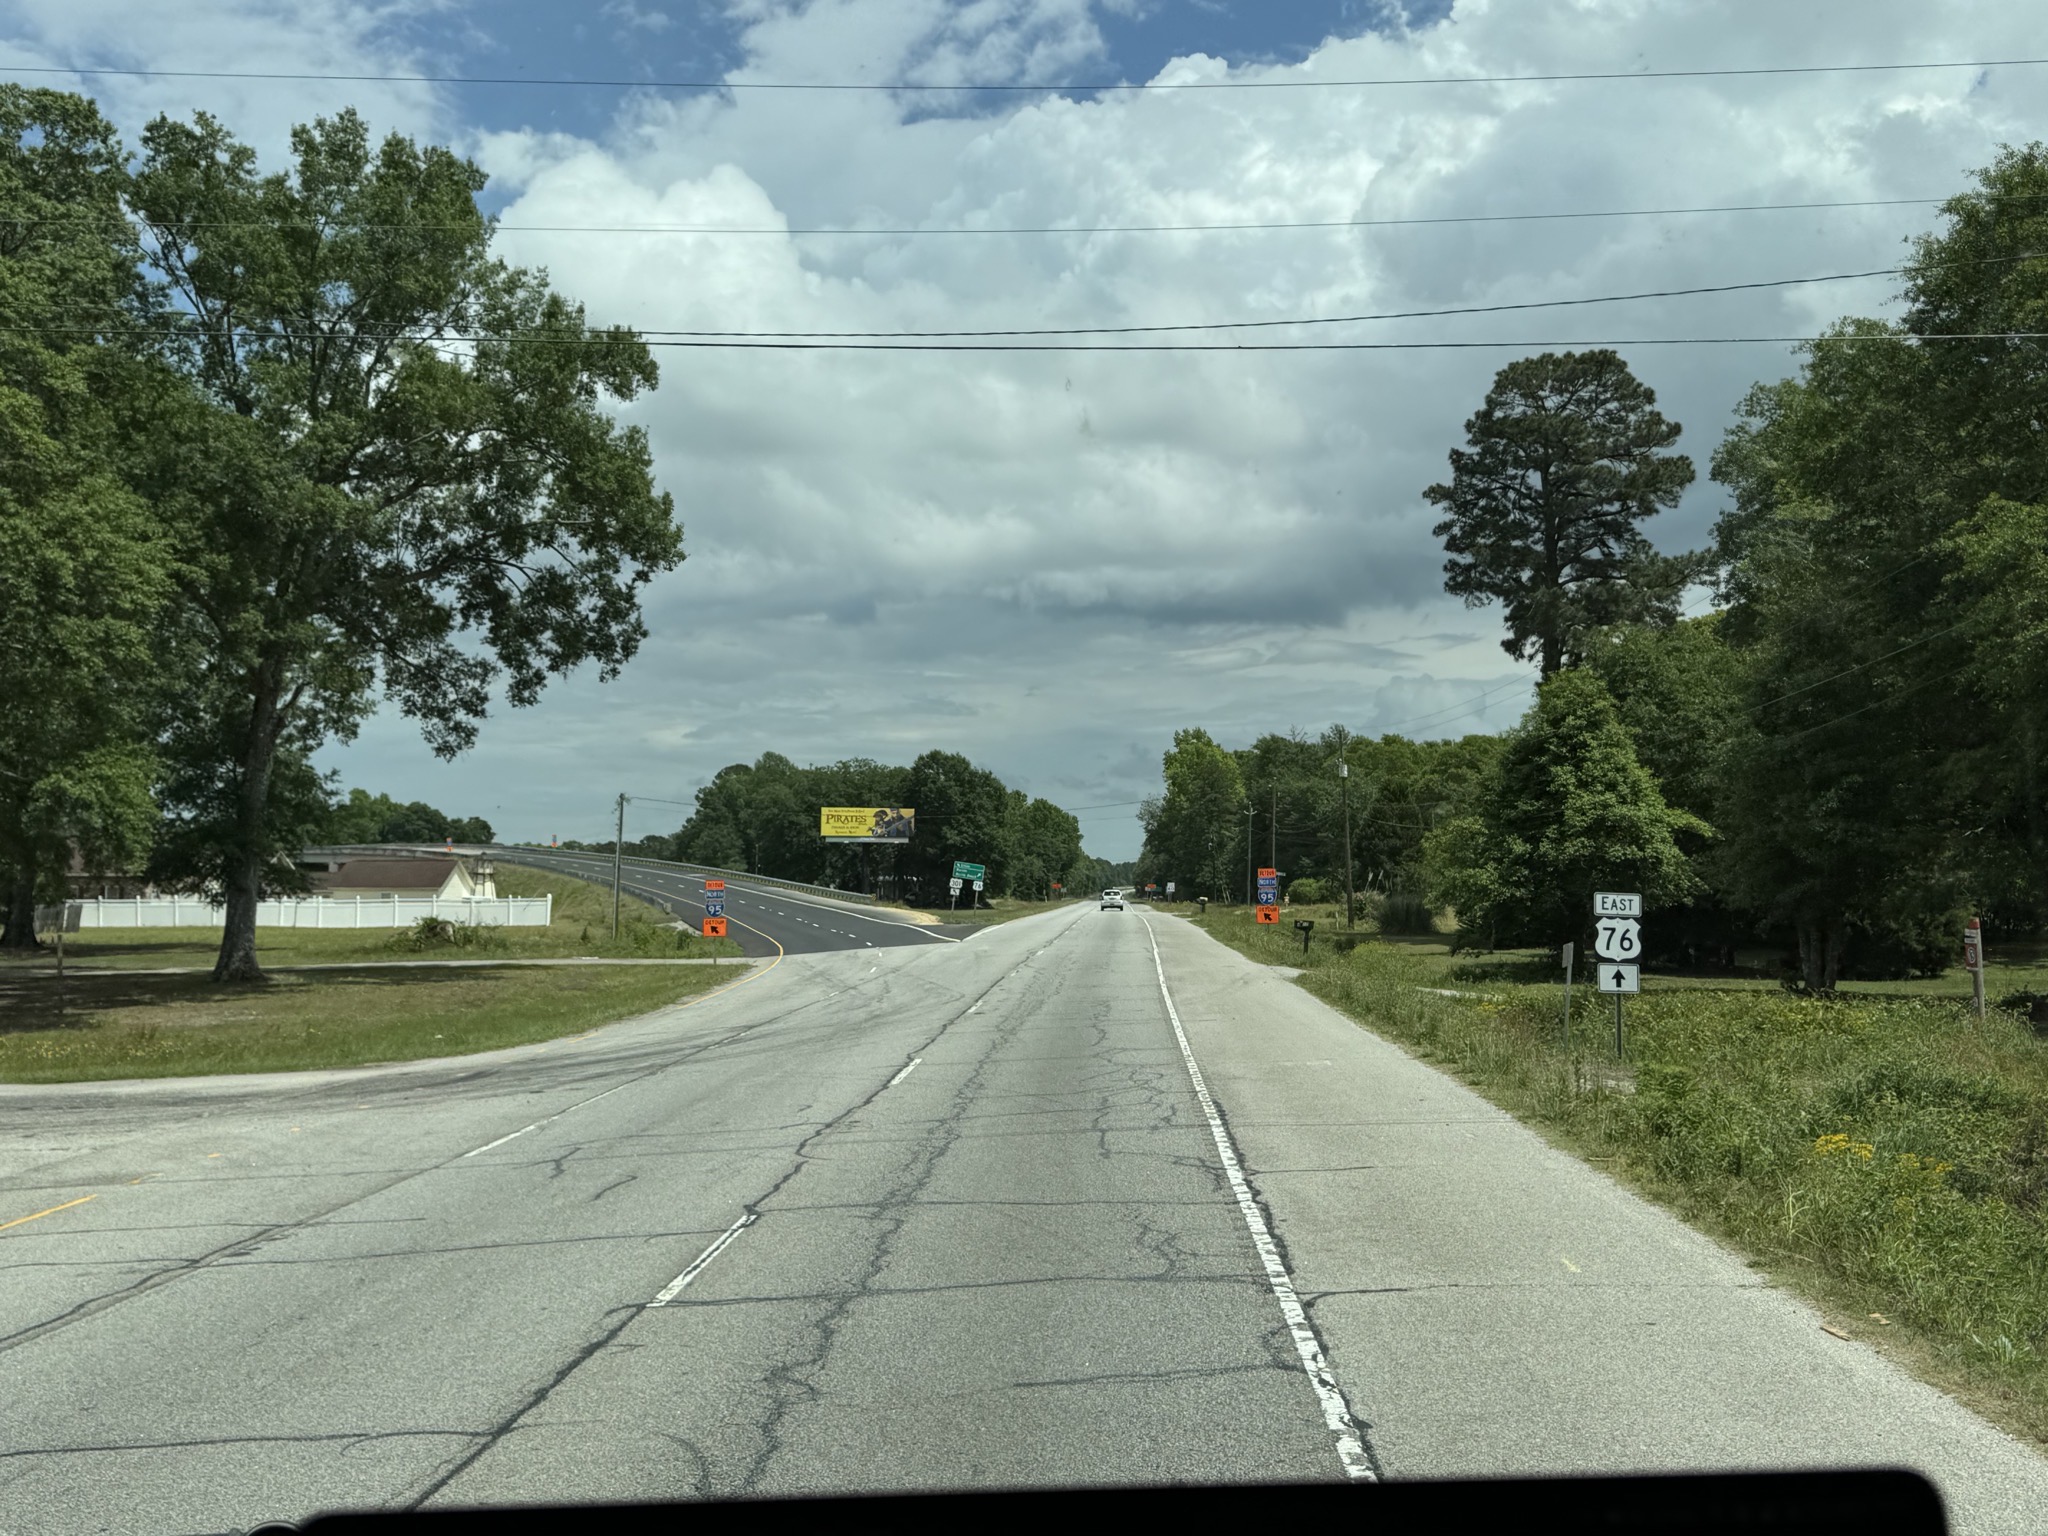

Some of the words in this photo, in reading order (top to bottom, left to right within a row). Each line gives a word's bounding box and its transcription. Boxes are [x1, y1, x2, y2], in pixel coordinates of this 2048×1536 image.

[826, 814, 866, 824] PIRATES
[1261, 894, 1274, 902] 95
[1601, 896, 1634, 911] EAST
[708, 906, 722, 914] 95
[1602, 927, 1633, 952] 76
